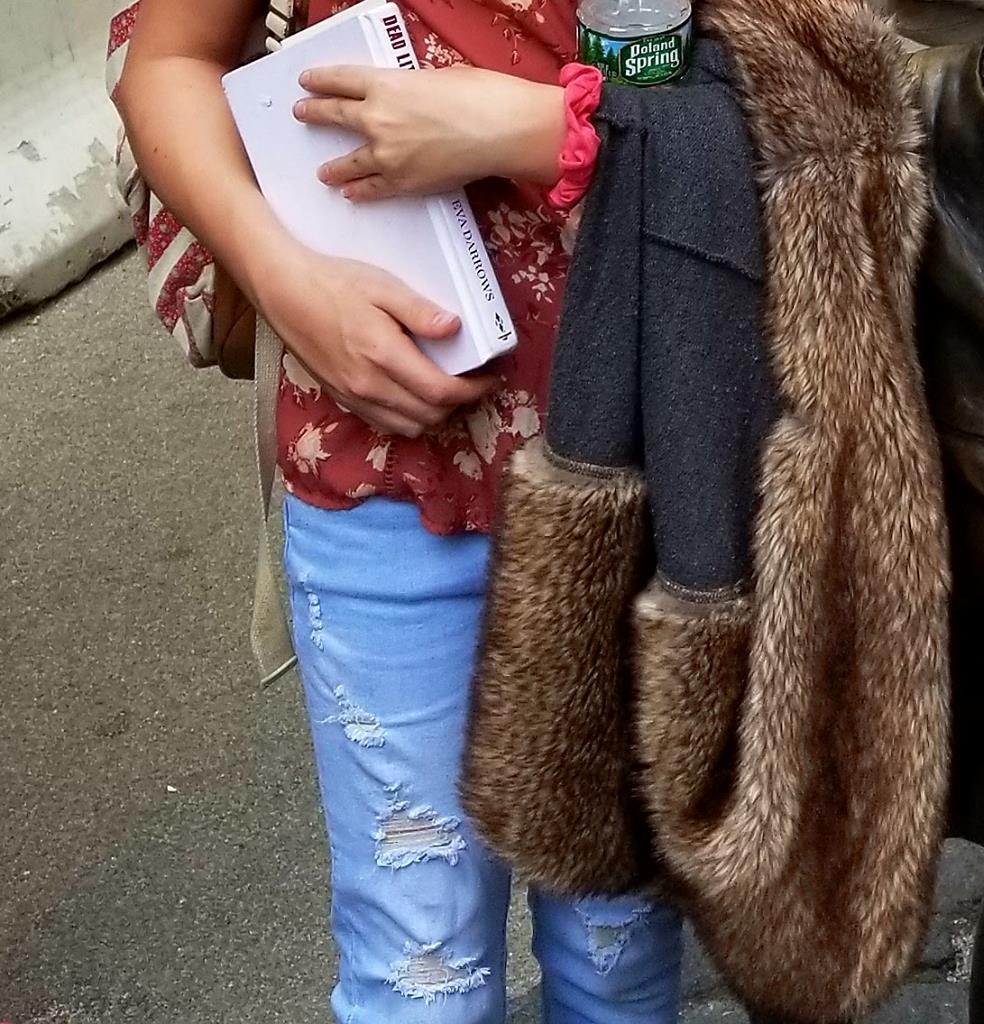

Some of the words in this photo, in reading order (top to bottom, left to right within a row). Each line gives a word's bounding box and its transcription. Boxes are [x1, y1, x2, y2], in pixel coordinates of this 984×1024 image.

[382, 14, 407, 50] DEAD
[396, 52, 416, 70] LI
[625, 48, 680, 77] Spring
[630, 36, 675, 59] Poland
[451, 199, 468, 229] EVA
[462, 229, 496, 303] DARROWS
